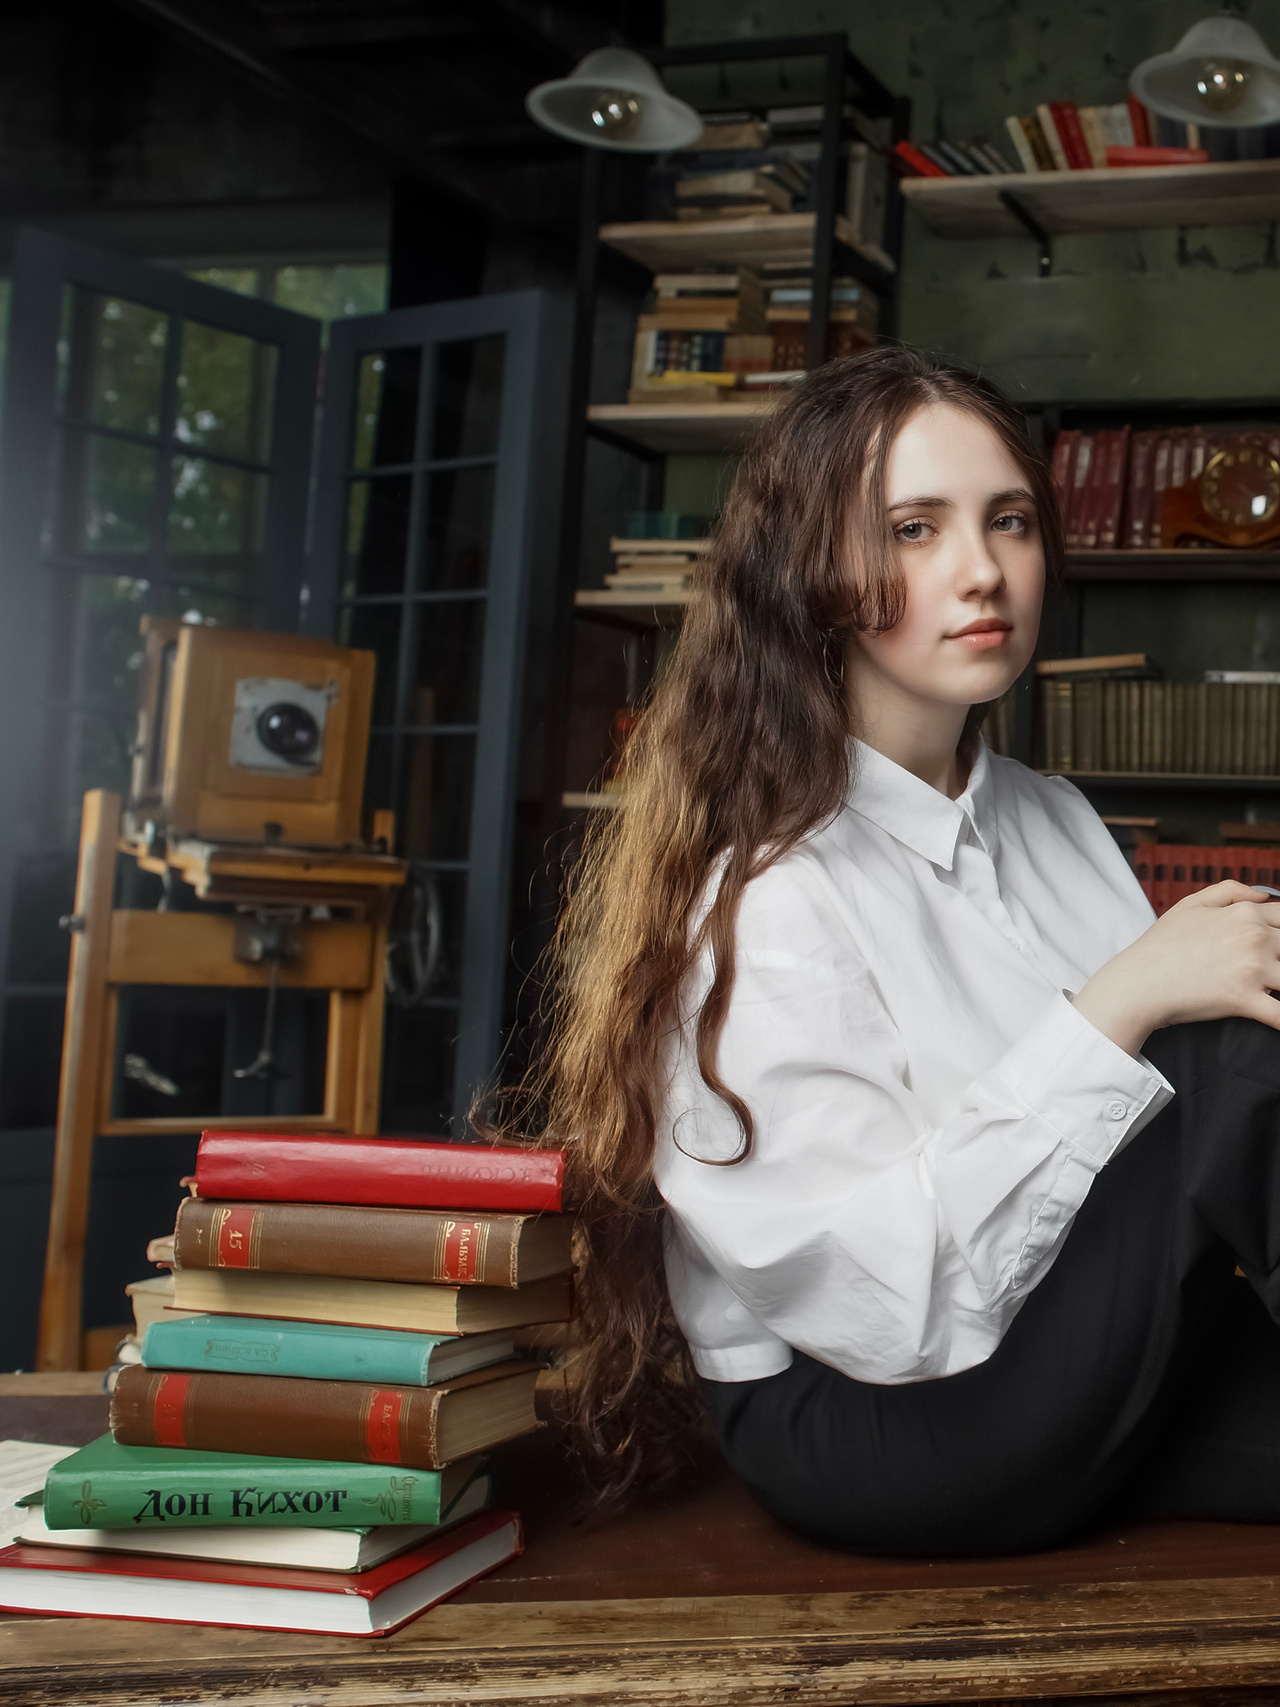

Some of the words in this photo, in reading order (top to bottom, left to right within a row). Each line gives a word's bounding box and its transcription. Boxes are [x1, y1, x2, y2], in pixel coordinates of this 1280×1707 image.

[228, 1229, 243, 1250] 15
[458, 1228, 471, 1277] БАЛЬЗАК
[132, 1489, 213, 1524] Дон
[229, 1487, 348, 1518] Кихот
